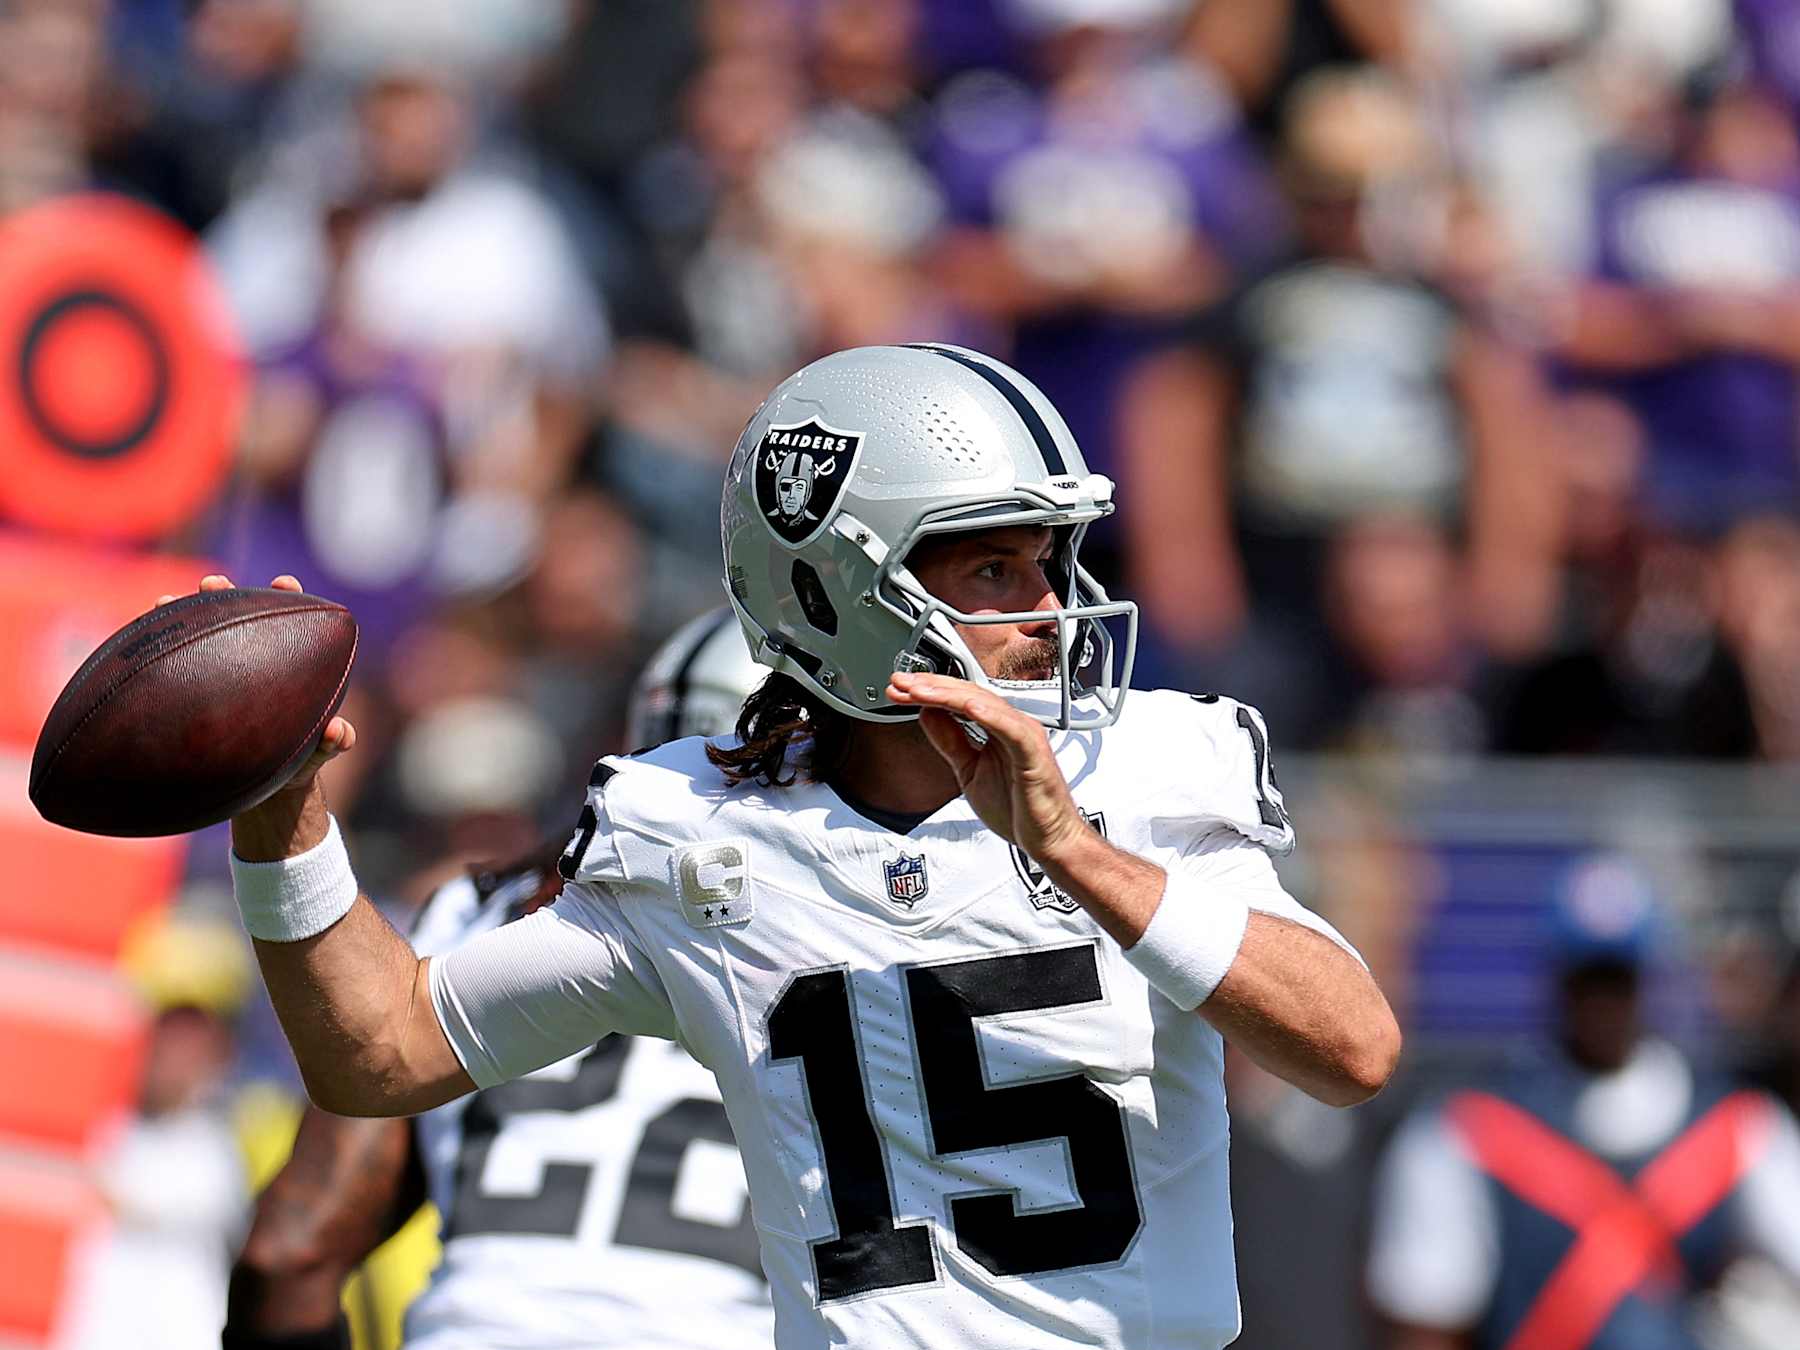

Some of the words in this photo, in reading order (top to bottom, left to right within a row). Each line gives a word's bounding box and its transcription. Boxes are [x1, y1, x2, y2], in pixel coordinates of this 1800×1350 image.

[768, 432, 848, 452] RAIDERS
[679, 847, 743, 905] C
[892, 875, 922, 896] NFL
[764, 939, 1144, 1306] 15
